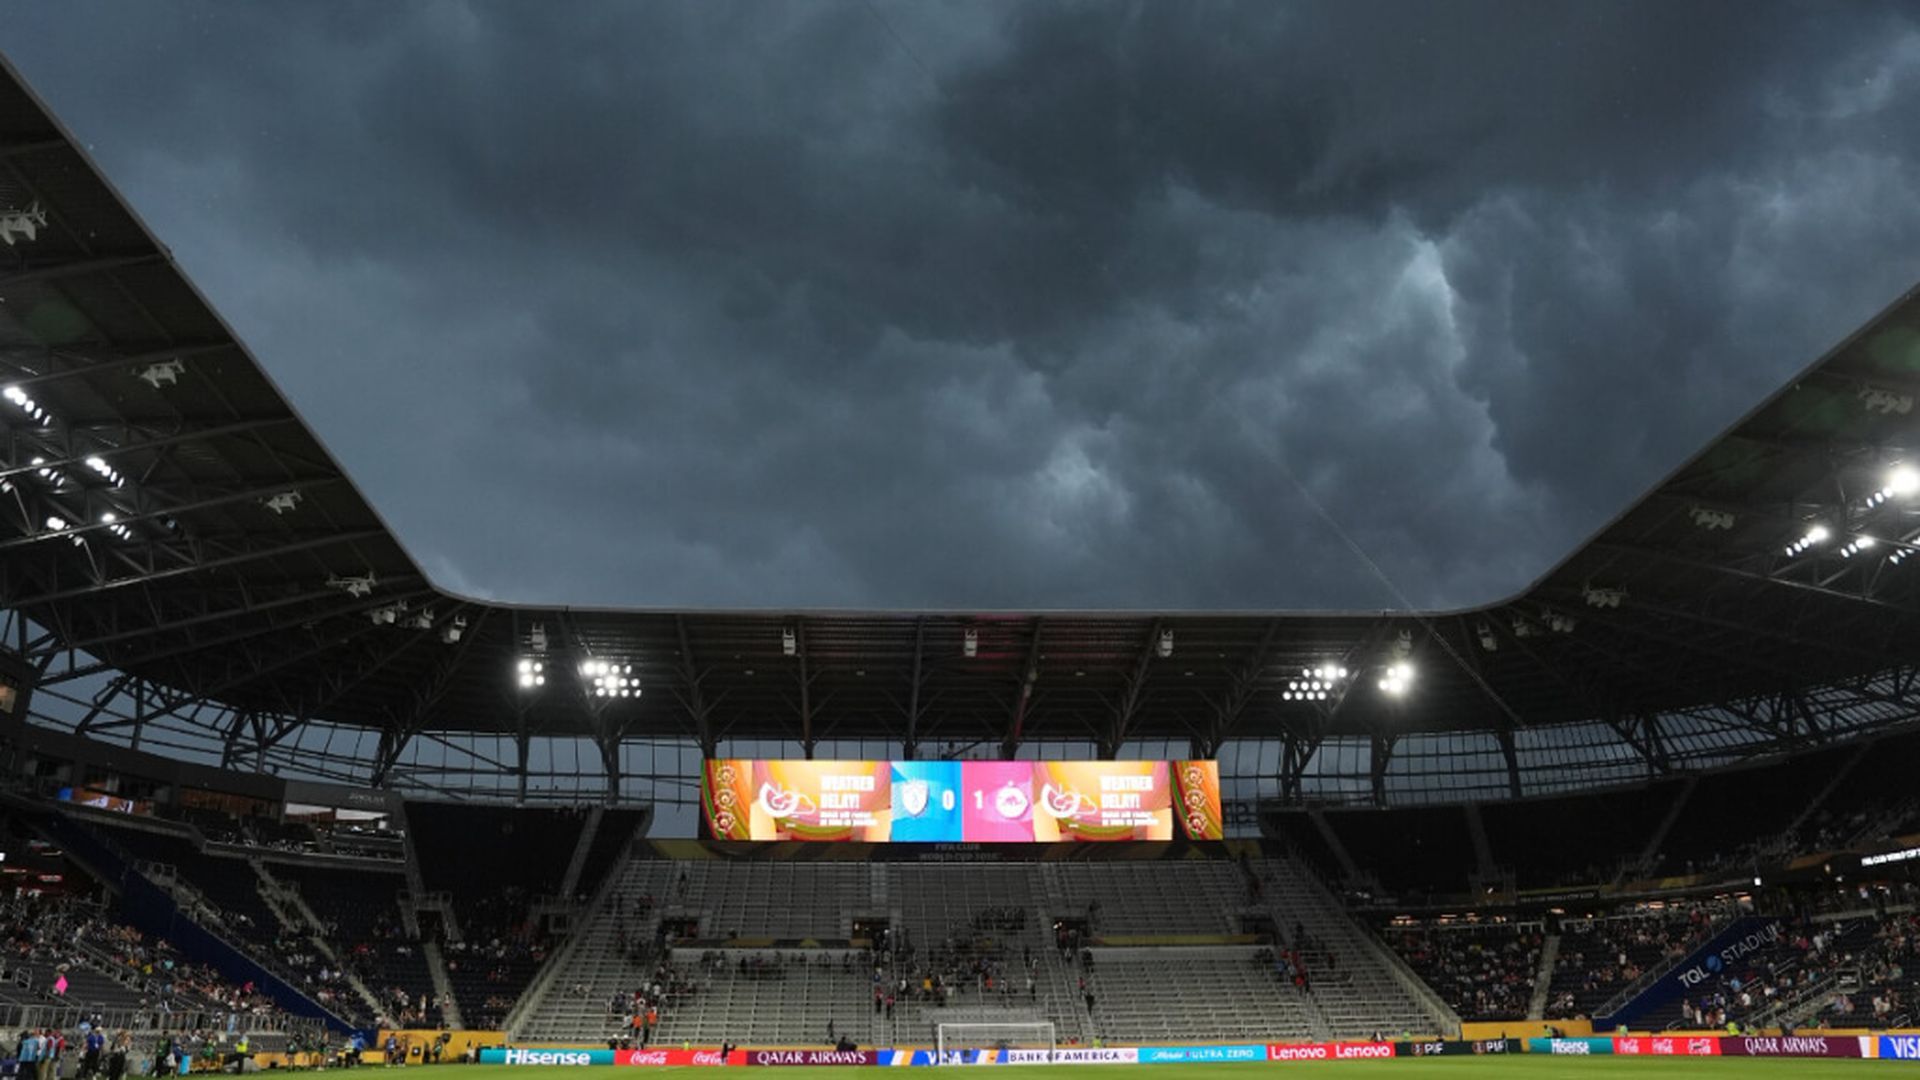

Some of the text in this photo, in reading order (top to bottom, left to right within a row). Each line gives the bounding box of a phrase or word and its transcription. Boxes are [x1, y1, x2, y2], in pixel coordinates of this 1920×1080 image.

[820, 775, 875, 791] WEATHER
[1101, 775, 1153, 791] WEATHER
[942, 789, 955, 810] 0
[973, 790, 984, 810] 1
[1678, 924, 1778, 988] TQL STADIU
[1271, 1046, 1327, 1060] Lenovo
[1335, 1044, 1390, 1057] Lenovo
[1551, 1038, 1589, 1055] Hisense
[1744, 1037, 1828, 1055] QATAR AIRWAYS
[505, 1049, 591, 1065] Hisense
[757, 1050, 866, 1066] QATAR AIRWAYS
[1010, 1051, 1043, 1062] BANK
[1064, 1051, 1119, 1061] AMERICA
[1192, 1050, 1223, 1060] ULTRA
